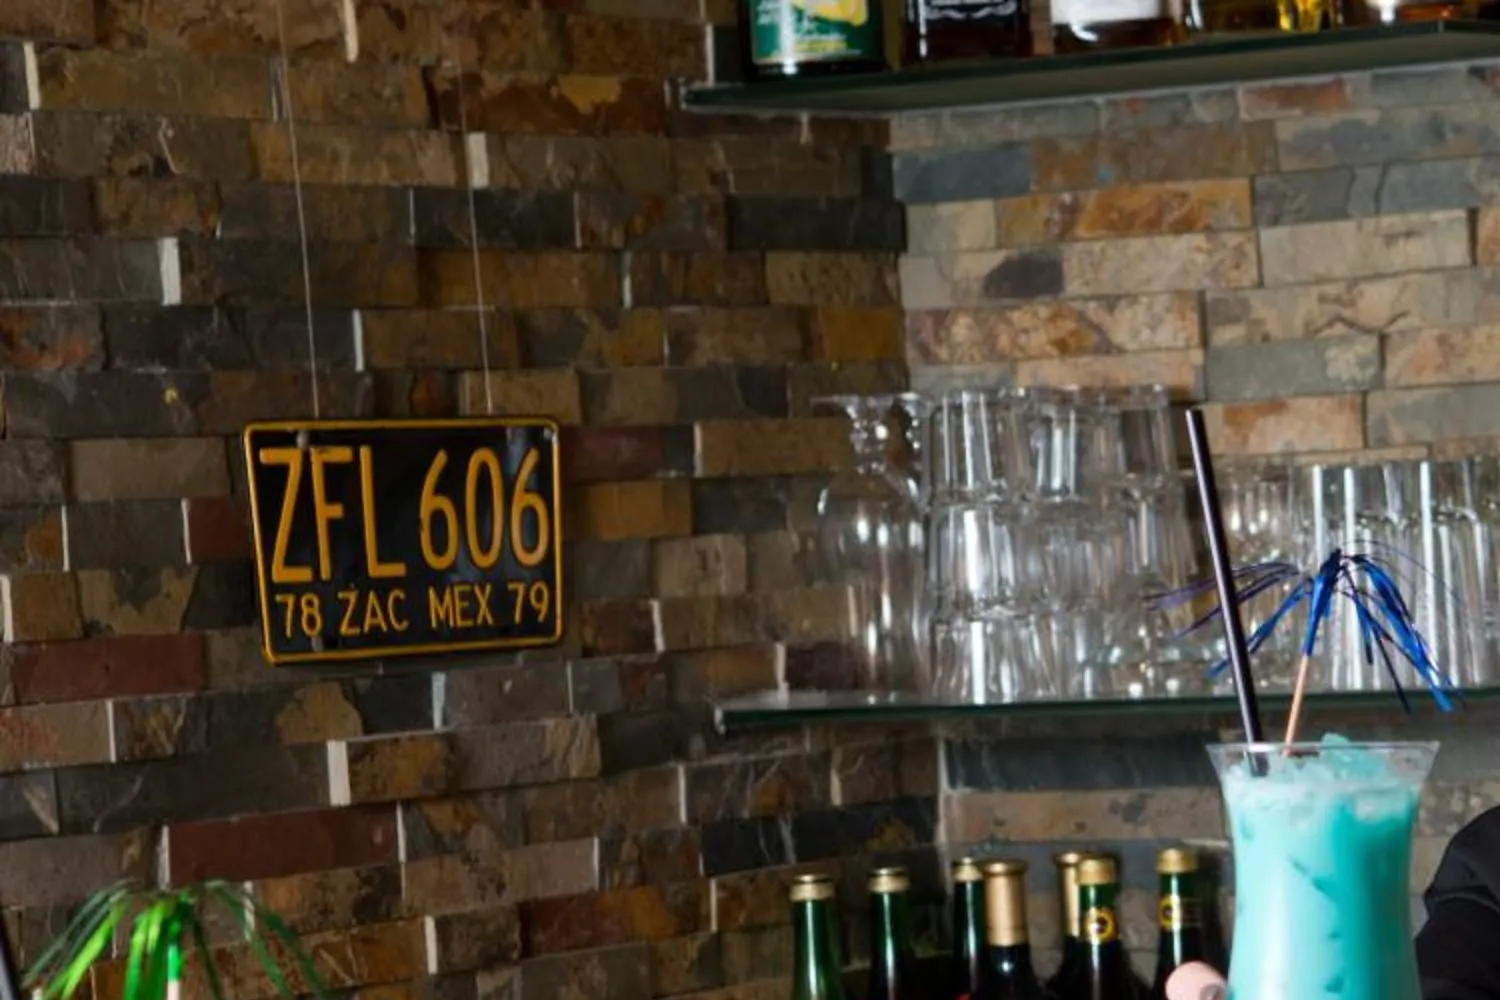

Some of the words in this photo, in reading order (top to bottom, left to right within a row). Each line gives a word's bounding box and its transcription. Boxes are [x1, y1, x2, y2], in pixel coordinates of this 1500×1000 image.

[259, 446, 406, 582] ZFL
[420, 448, 549, 570] 606
[275, 593, 323, 638] 78
[338, 589, 409, 635] ZAC
[428, 583, 493, 629] MEX
[507, 580, 549, 624] 79
